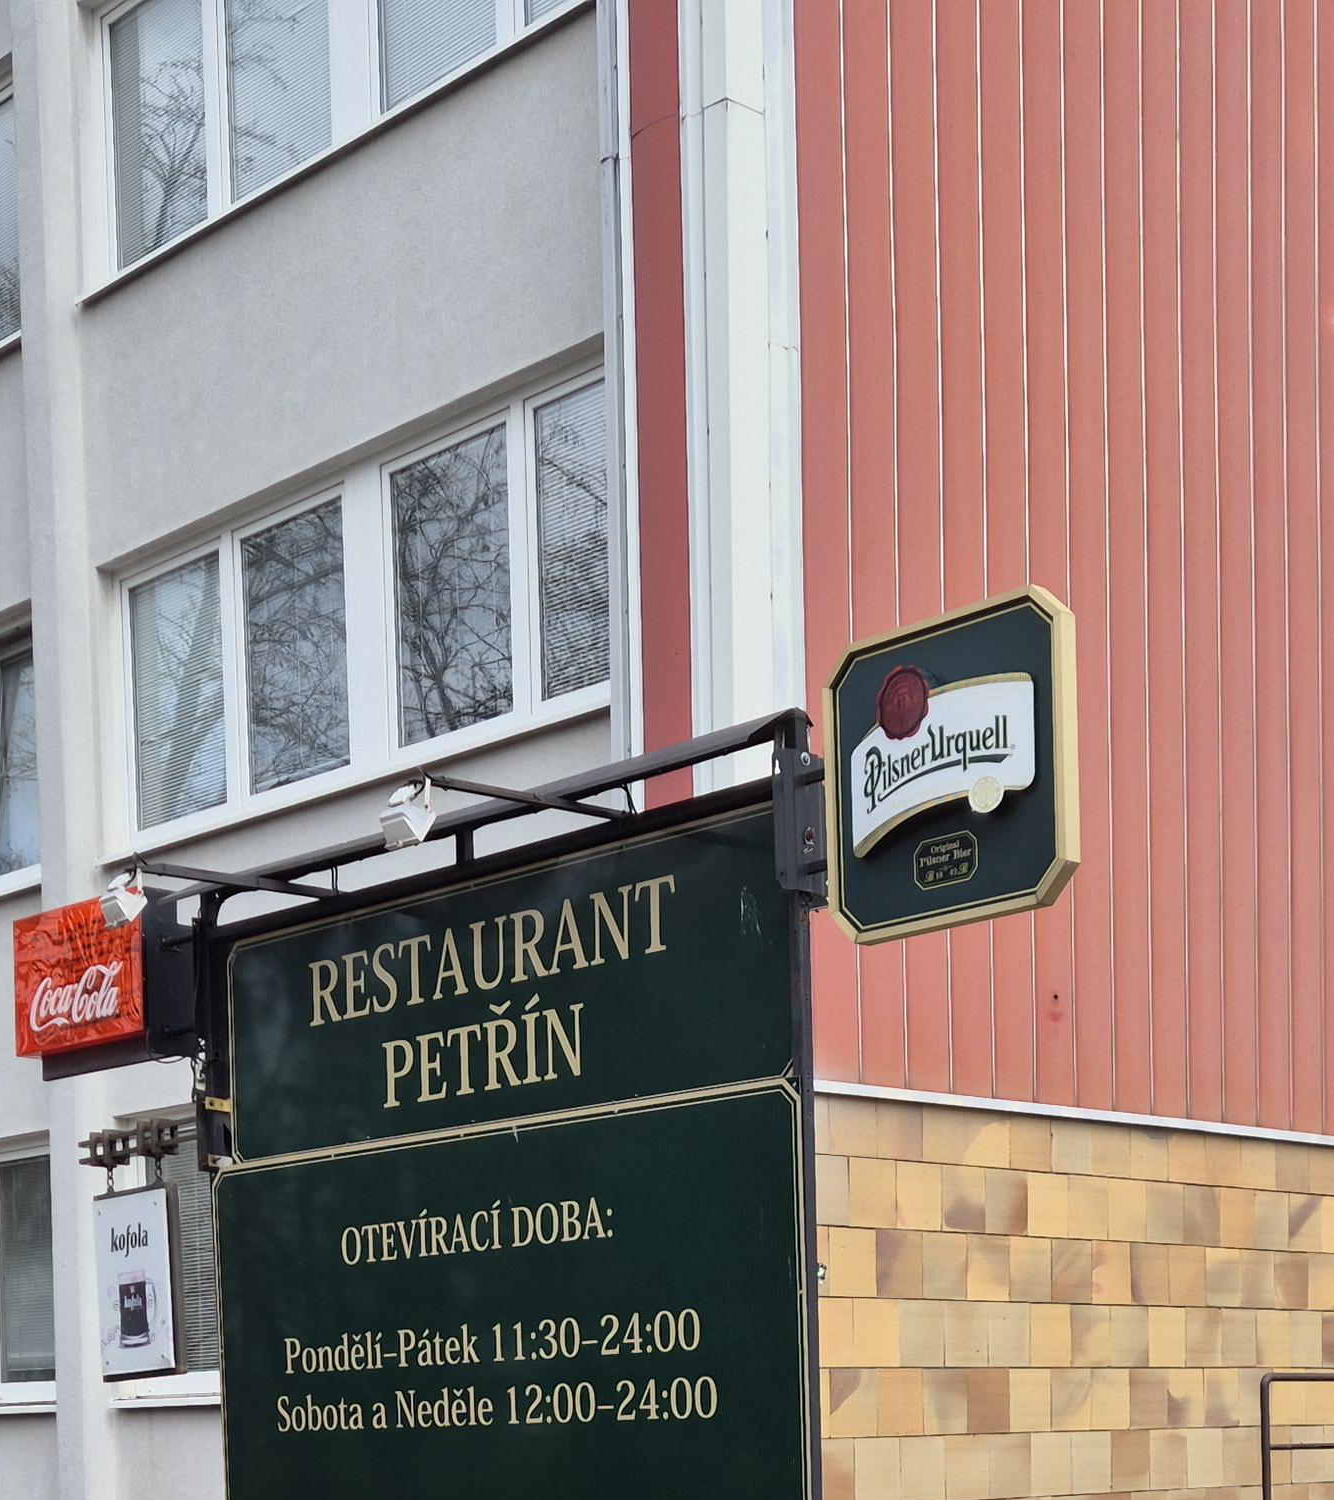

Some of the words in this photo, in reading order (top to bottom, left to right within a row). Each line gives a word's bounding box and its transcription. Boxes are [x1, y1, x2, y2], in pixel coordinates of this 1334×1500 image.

[307, 874, 676, 1028] RESTAURANT
[381, 992, 584, 1109] PETŘÍN
[110, 1222, 149, 1257] kofola
[340, 1200, 502, 1265] OTEVÍRACÍ
[511, 1196, 614, 1248] DOBA:
[276, 1393, 365, 1433] Sobota
[371, 1402, 388, 1430] a
[395, 1385, 494, 1429] Neděle
